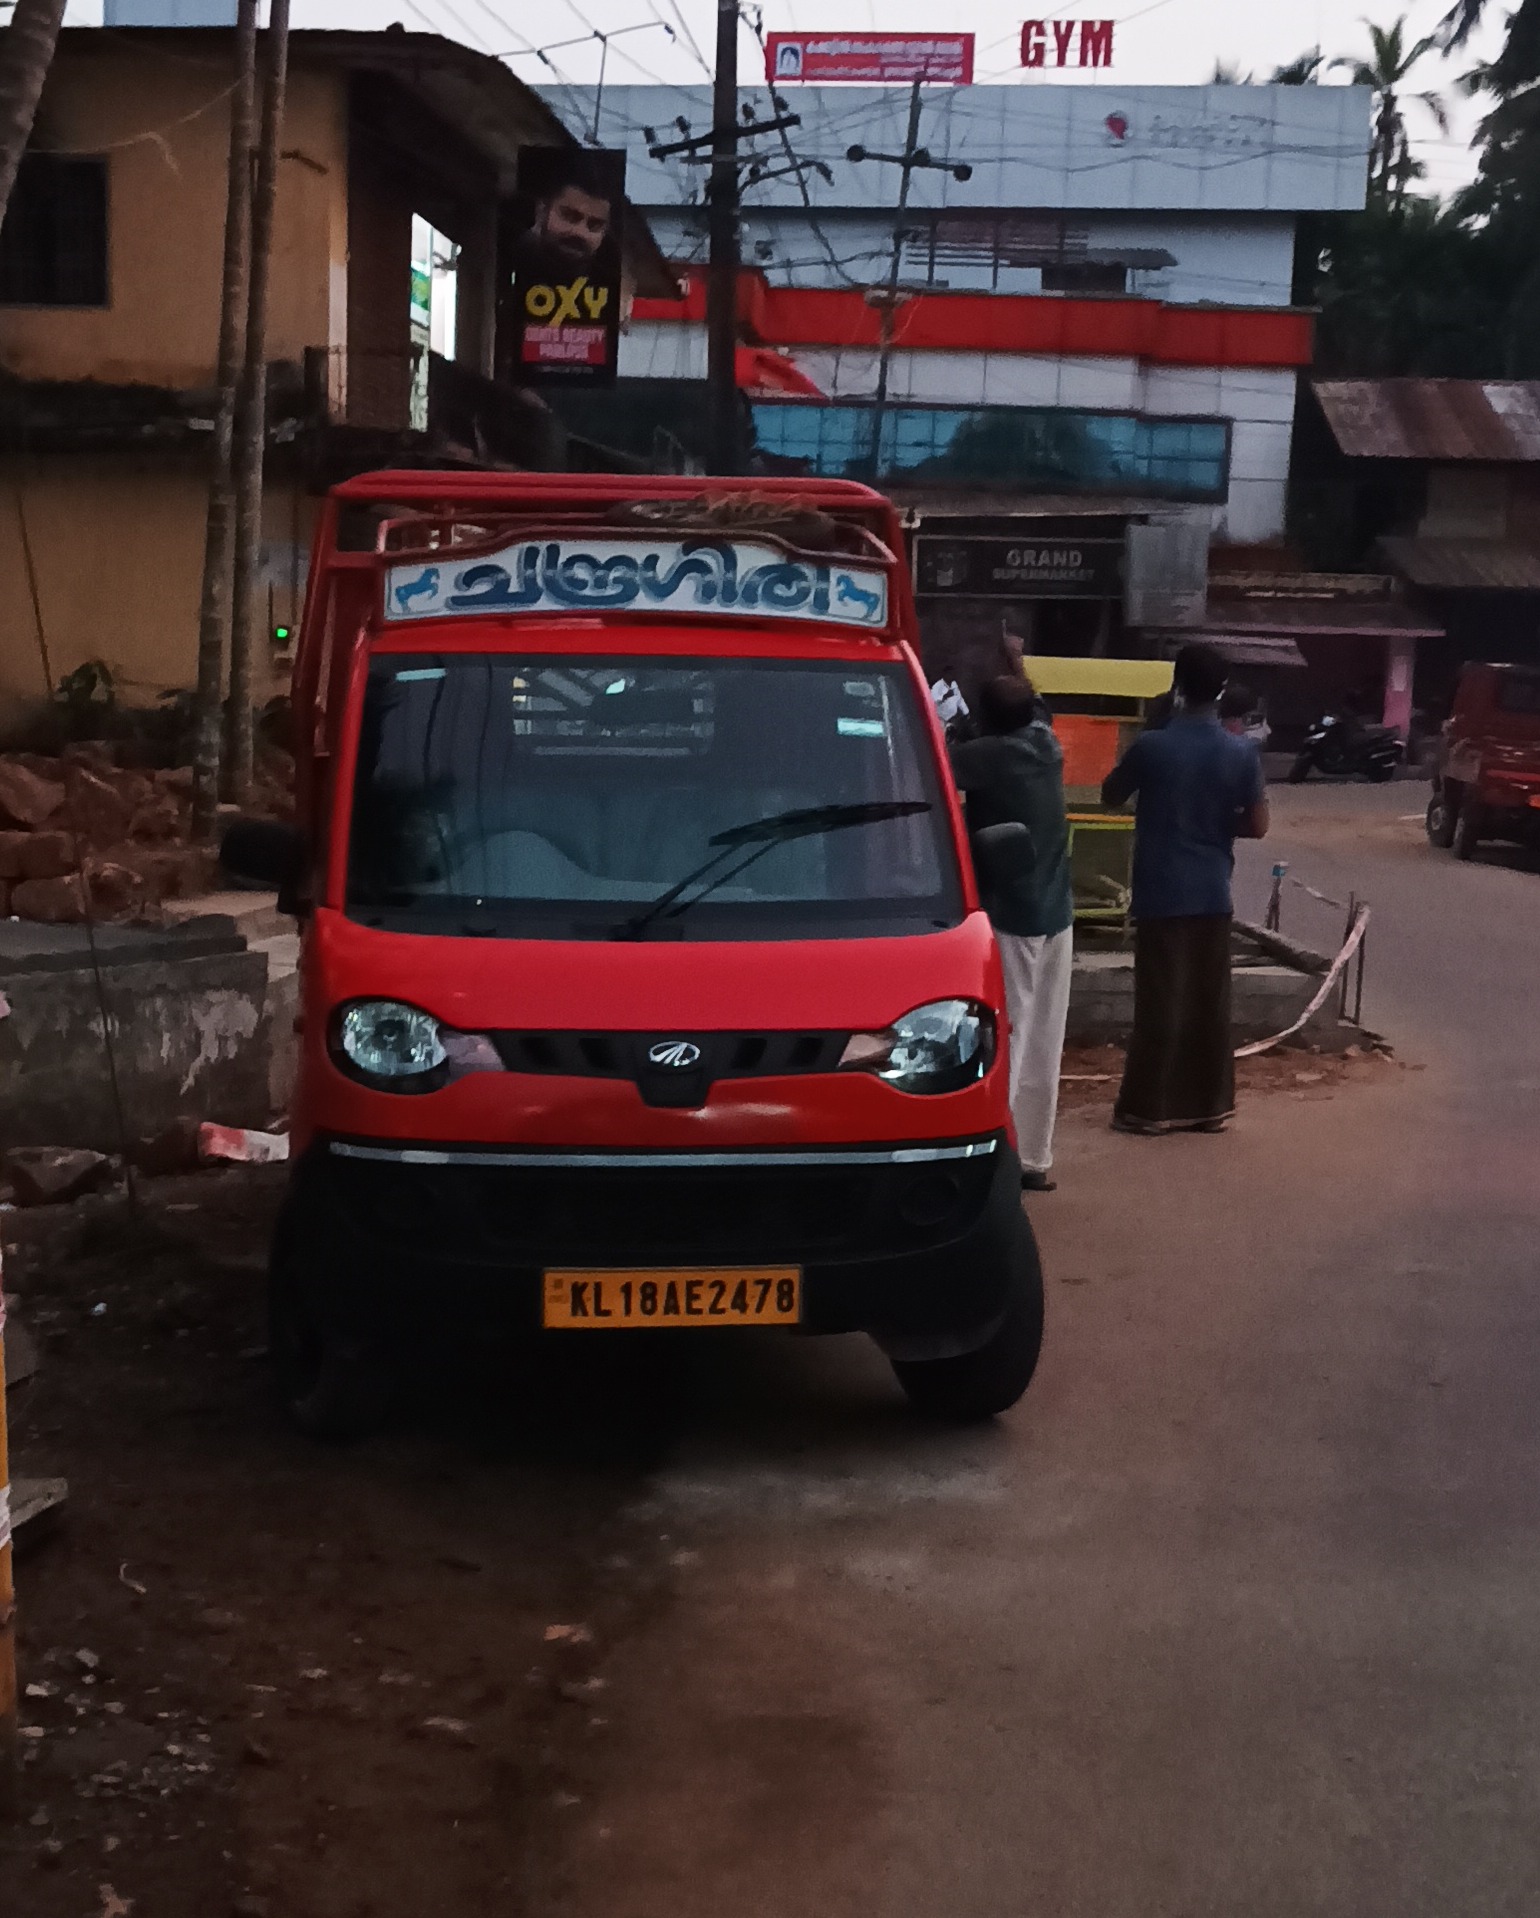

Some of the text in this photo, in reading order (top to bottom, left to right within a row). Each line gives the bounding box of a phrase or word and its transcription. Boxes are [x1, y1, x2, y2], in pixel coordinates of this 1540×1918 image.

[1019, 20, 1115, 67] GYM
[525, 276, 608, 327] OXY
[1005, 549, 1083, 567] GRAND
[570, 1278, 795, 1317] KL18AE2478
